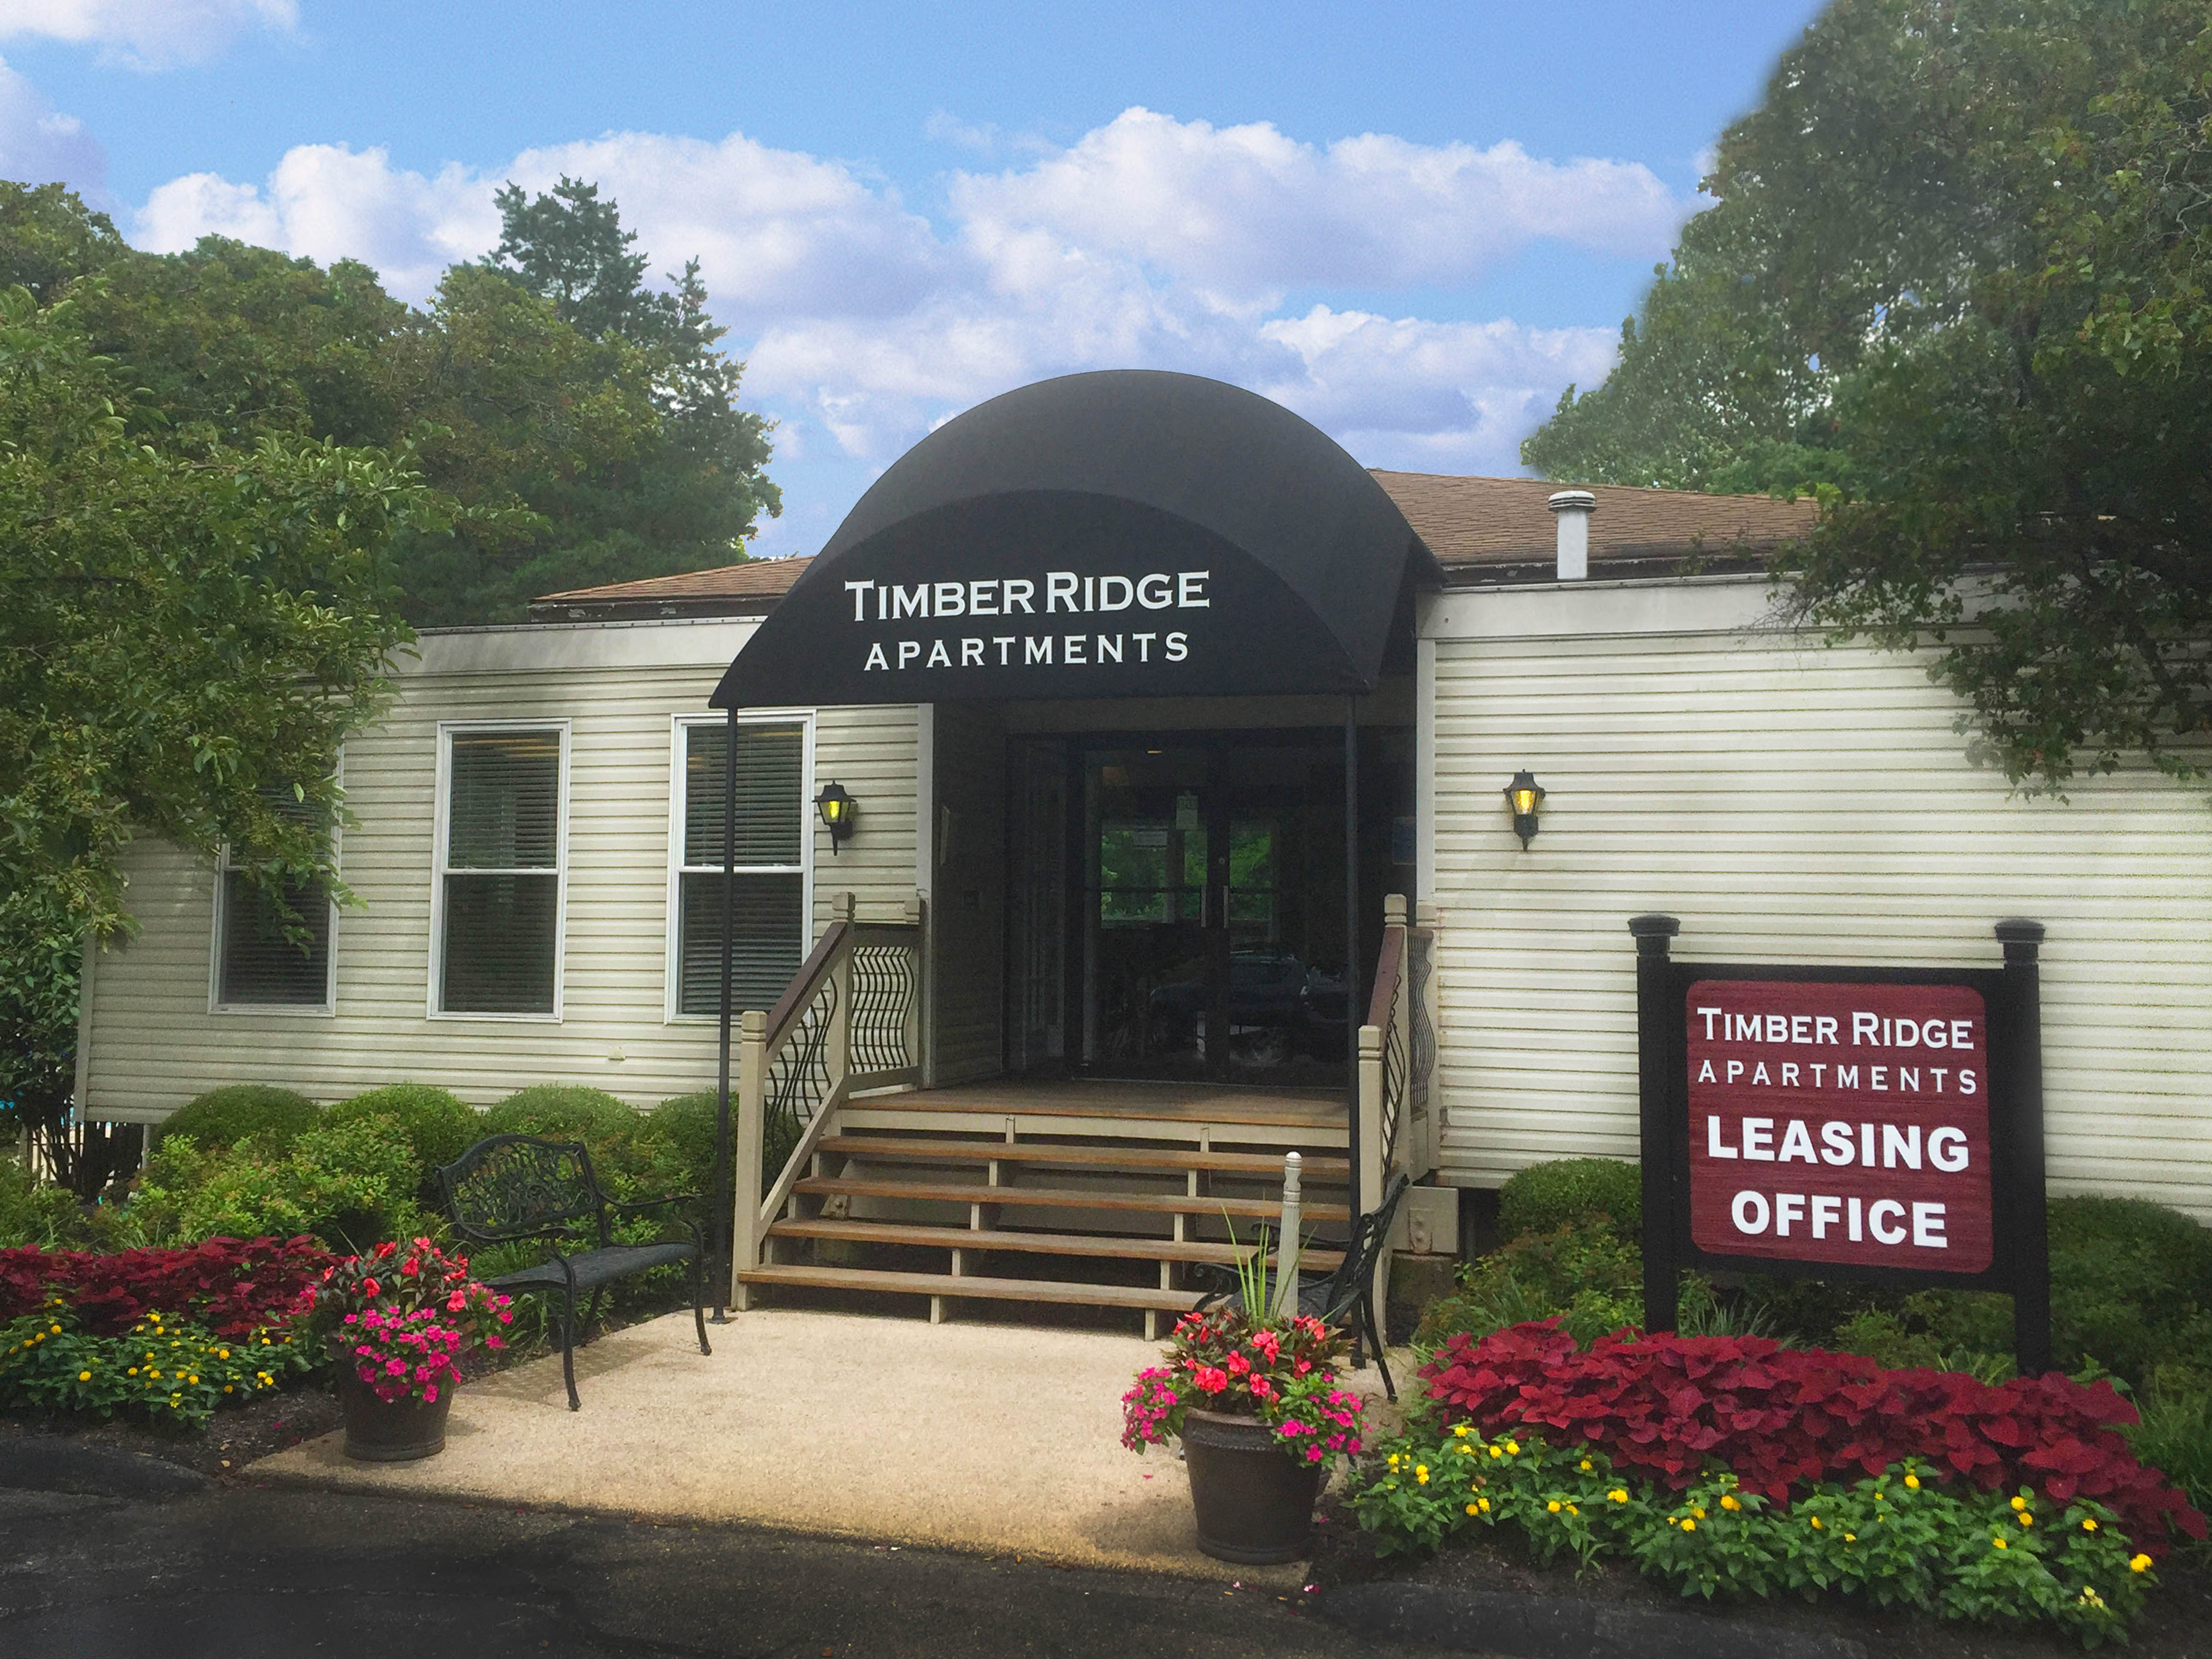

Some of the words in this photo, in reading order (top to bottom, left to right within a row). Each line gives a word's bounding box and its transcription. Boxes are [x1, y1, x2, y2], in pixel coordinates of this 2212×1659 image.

[844, 578, 1036, 622] TIMBER
[1045, 570, 1210, 613] RIDGE
[864, 631, 1188, 671] APARTMENTS
[1697, 1007, 1840, 1045] TIMBER
[1851, 1011, 1974, 1050] RIDGE
[1698, 1059, 1977, 1095] APARTMENTS
[1707, 1115, 1969, 1172] LEASING
[1731, 1190, 1948, 1248] OFFICE
